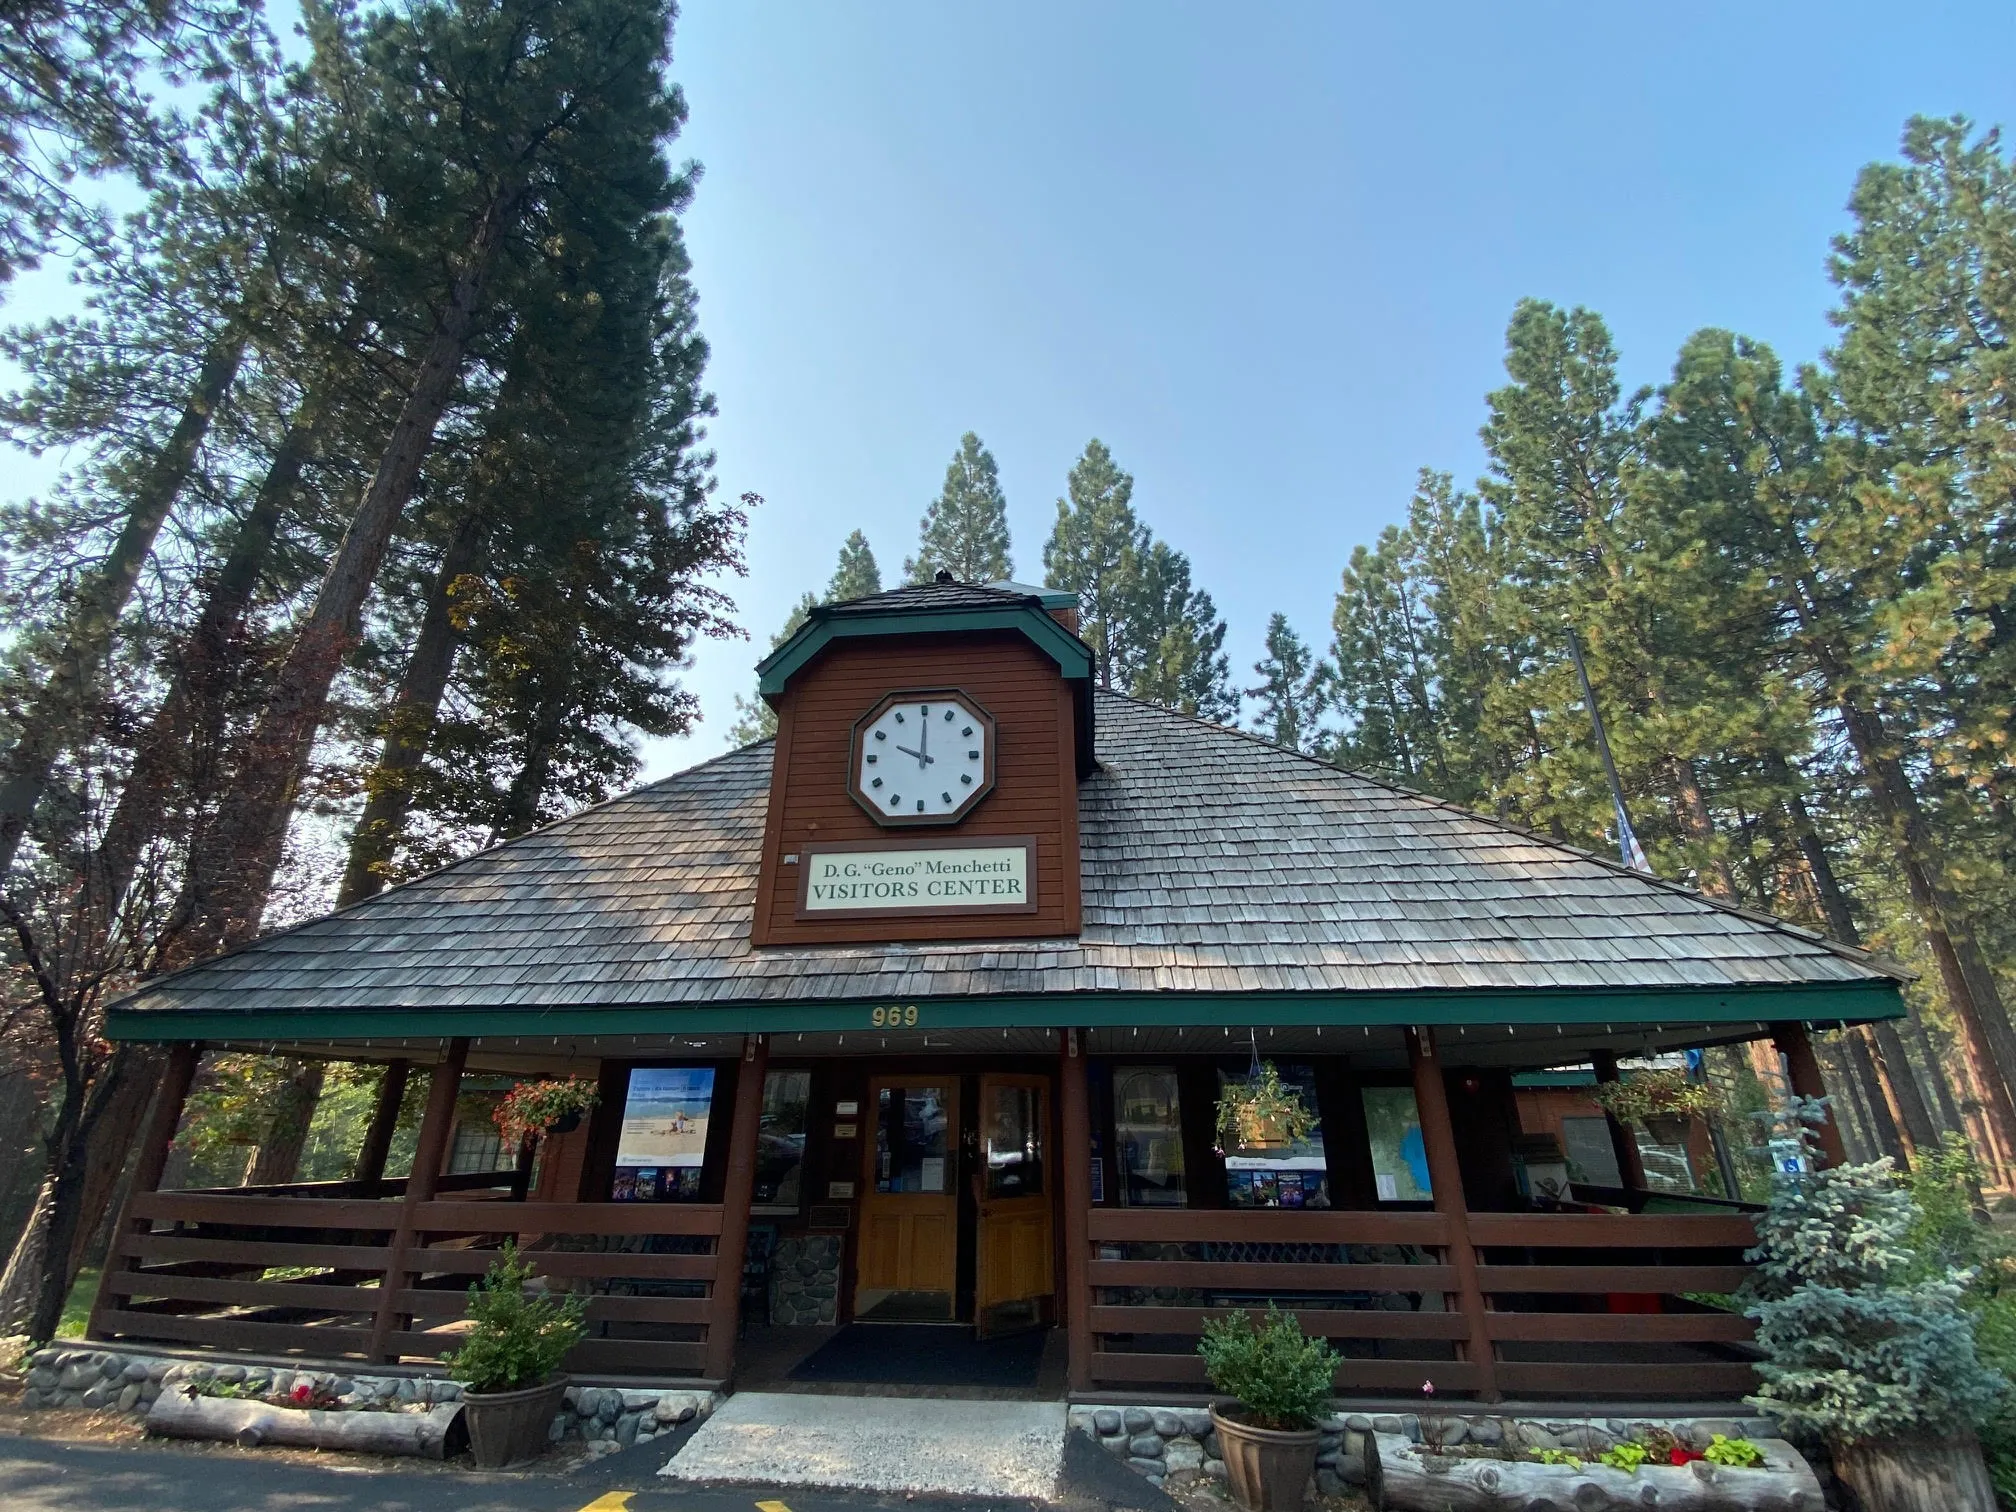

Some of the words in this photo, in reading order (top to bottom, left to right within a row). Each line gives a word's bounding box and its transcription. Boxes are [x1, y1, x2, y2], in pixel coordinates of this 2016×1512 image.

[824, 864, 840, 878] D.
[844, 863, 861, 877] G.
[925, 858, 1011, 875] Menchetti
[812, 881, 920, 900] VISITORS
[927, 878, 1022, 896] CENTER
[872, 1005, 918, 1027] 969
